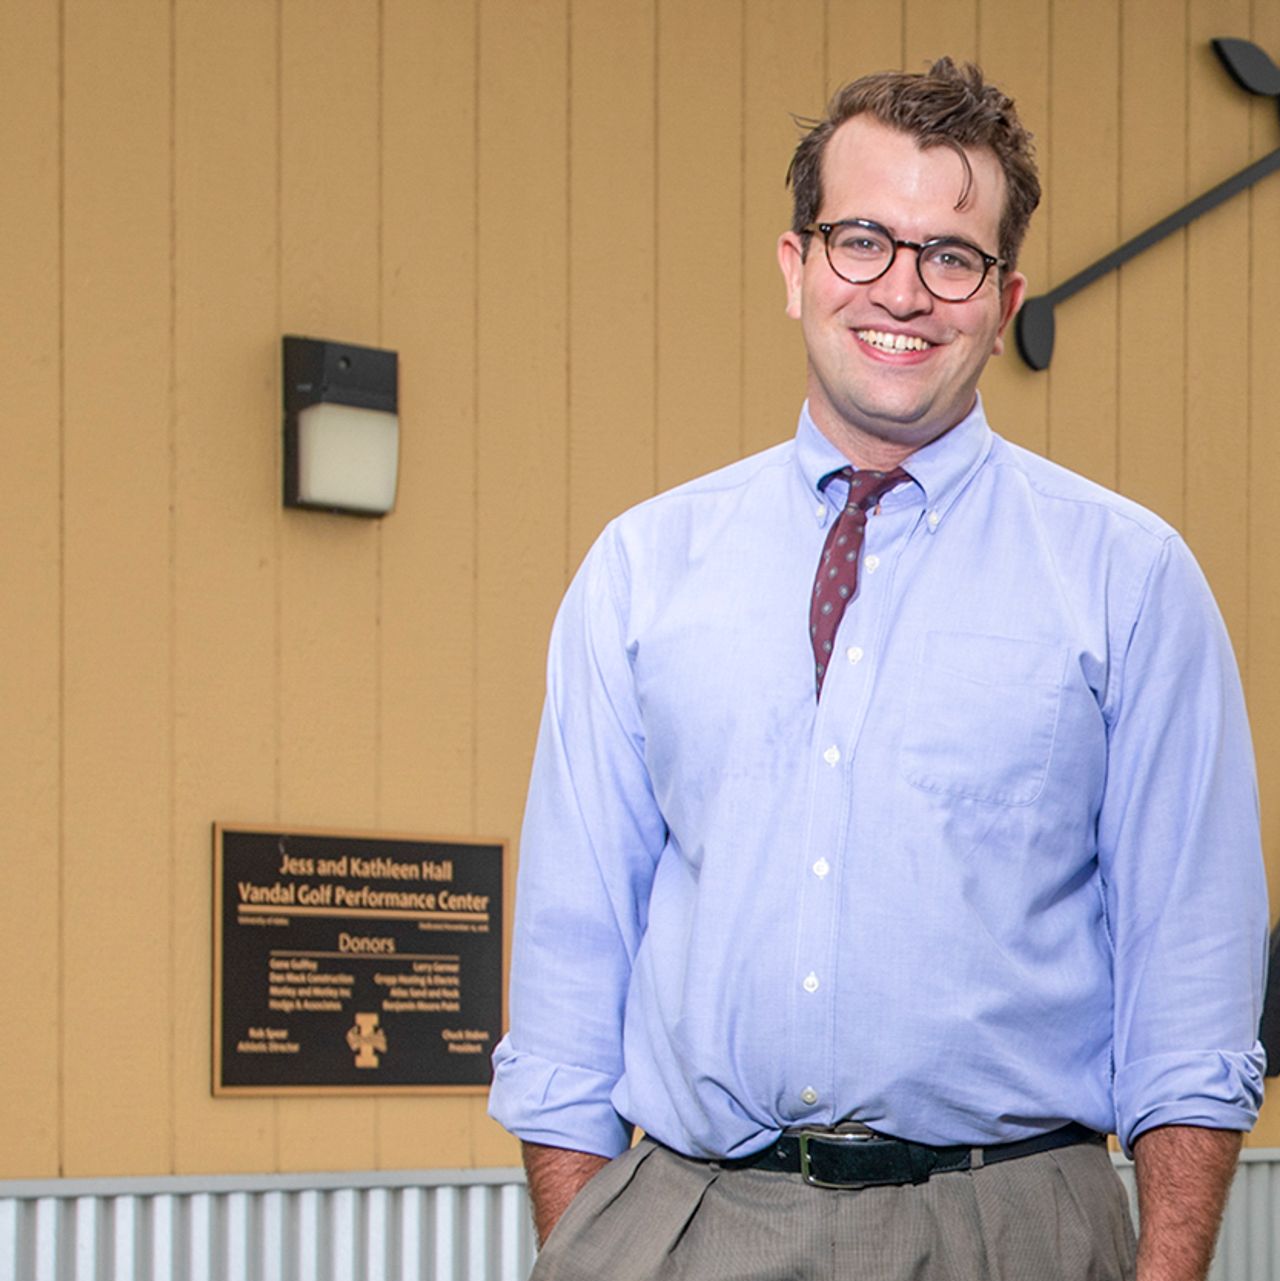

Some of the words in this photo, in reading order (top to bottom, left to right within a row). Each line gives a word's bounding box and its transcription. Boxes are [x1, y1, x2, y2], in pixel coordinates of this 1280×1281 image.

[280, 854, 314, 876] Jess
[317, 856, 347, 877] and
[350, 857, 419, 880] Kathleen
[422, 860, 452, 882] Hall
[238, 882, 295, 904] Vandal
[298, 884, 332, 906] Golf
[335, 886, 435, 911] Performance
[438, 890, 489, 912] Center
[338, 932, 395, 954] Donors
